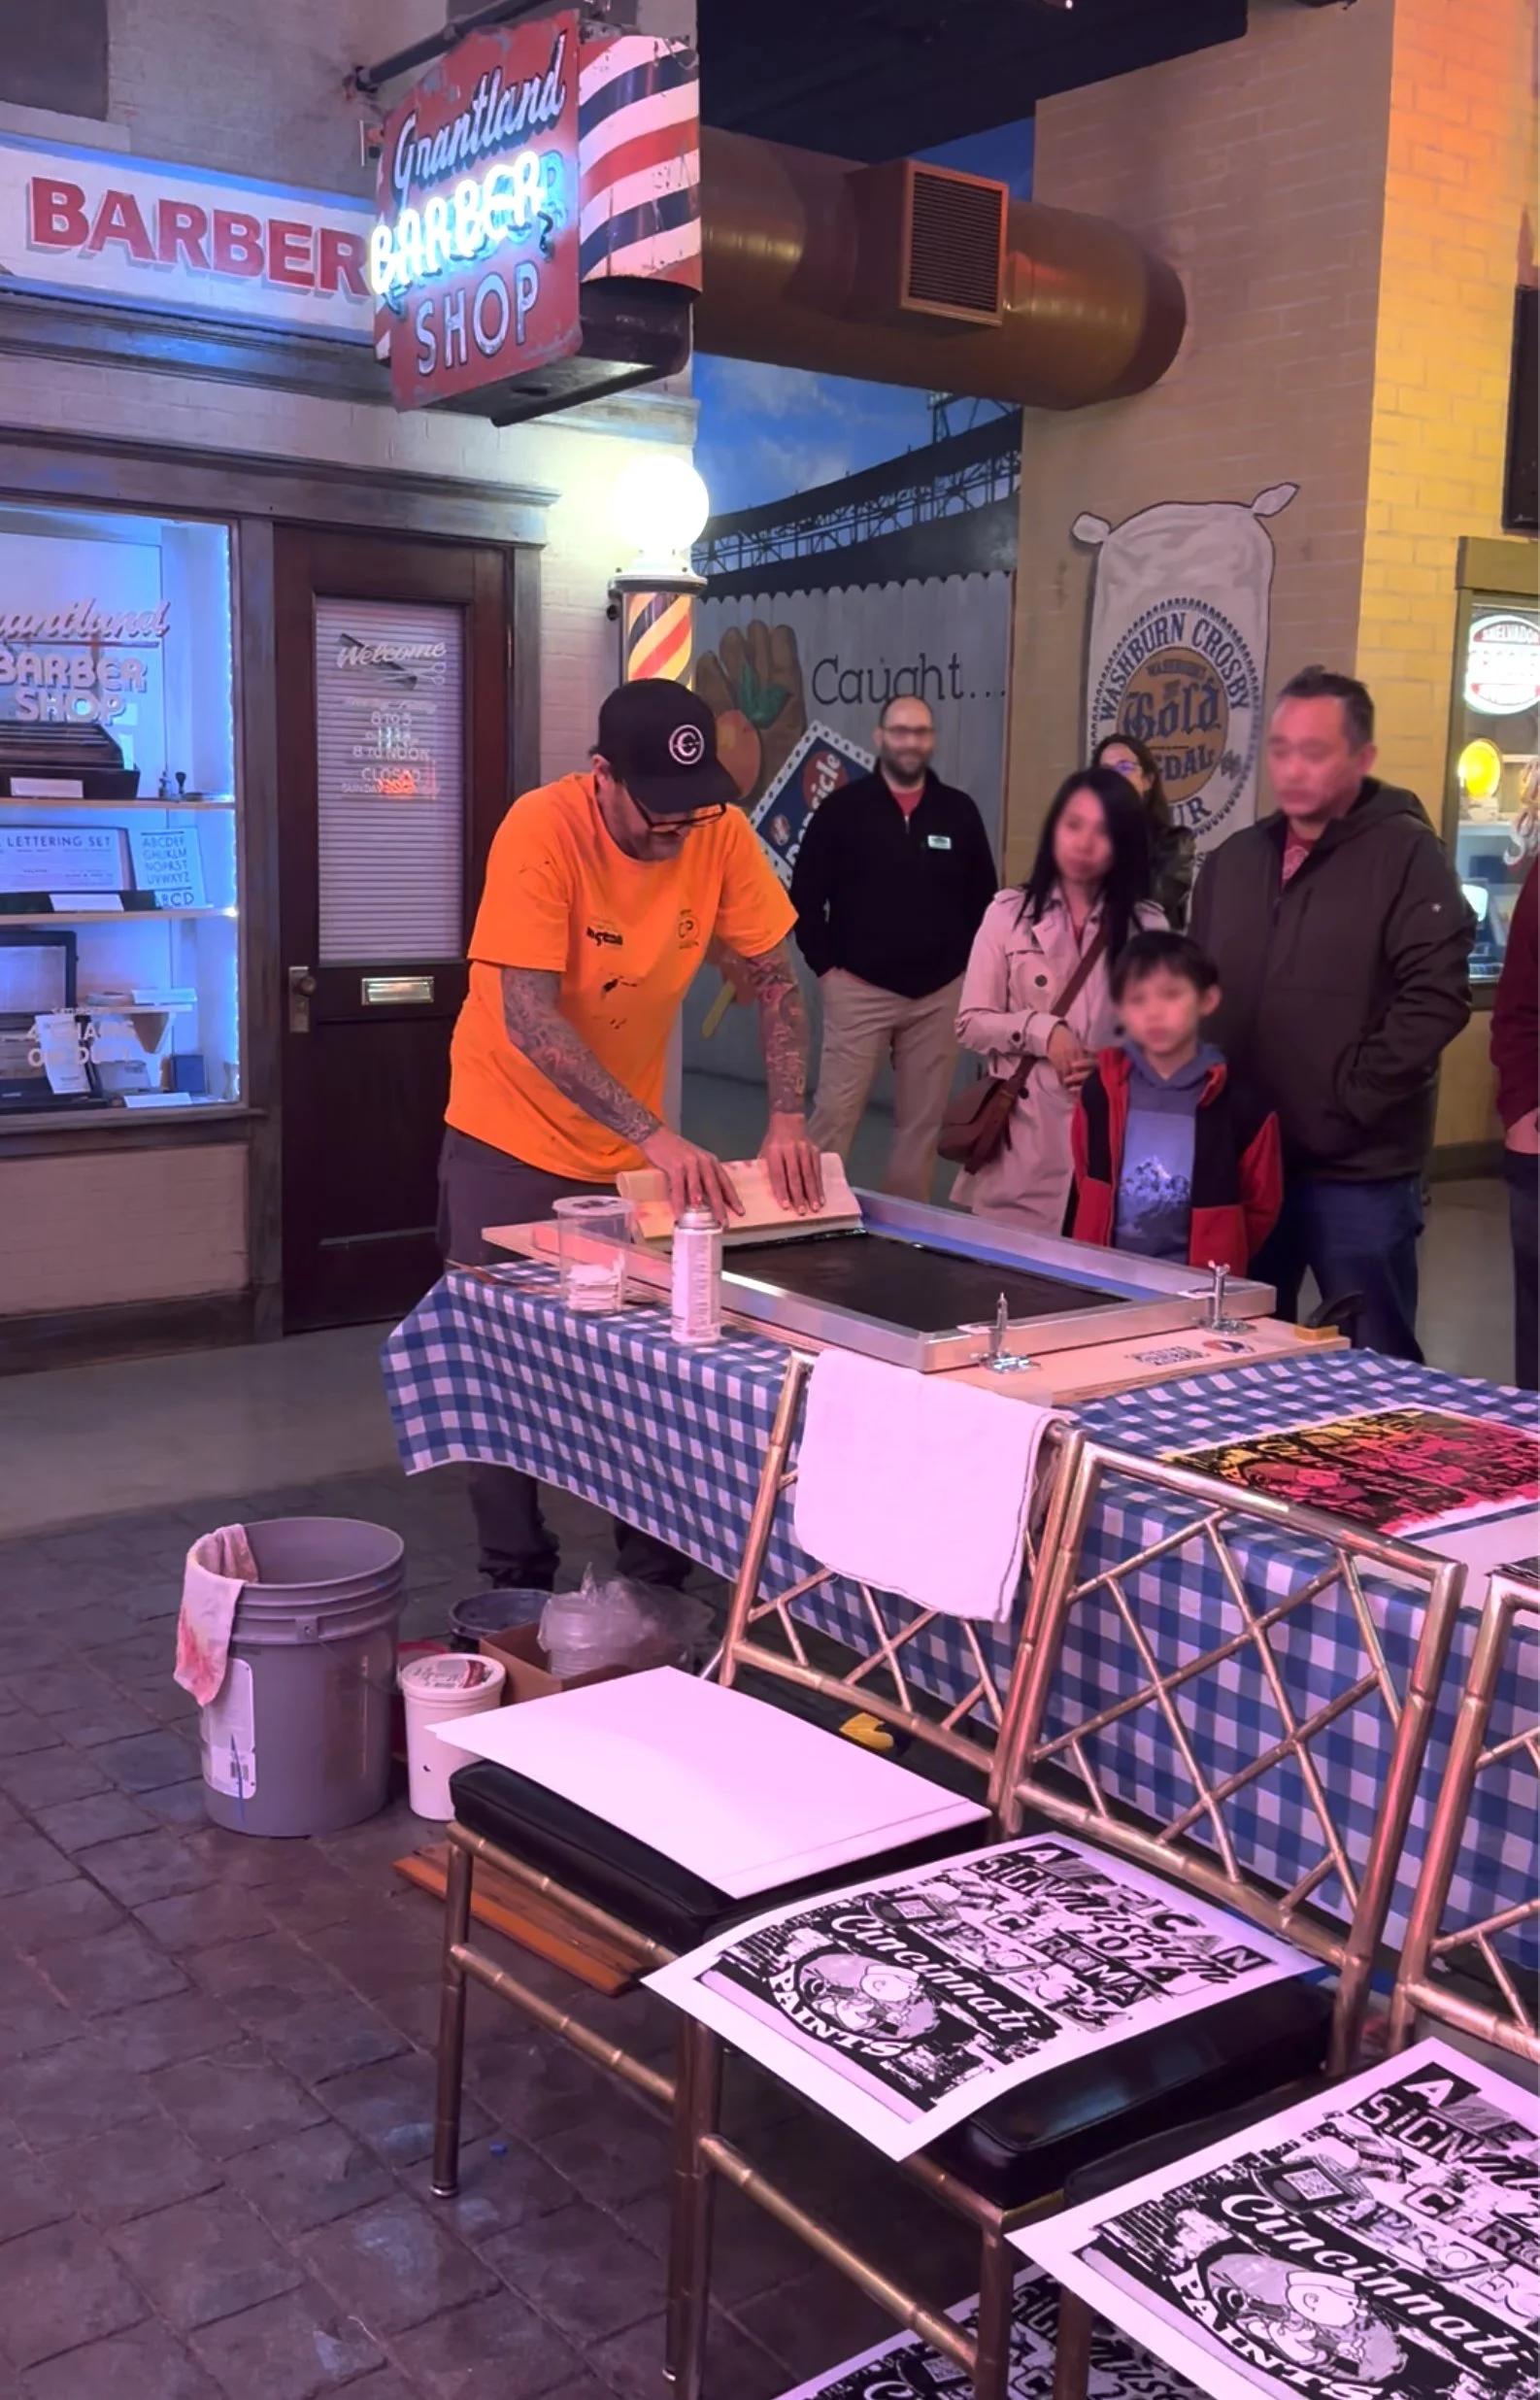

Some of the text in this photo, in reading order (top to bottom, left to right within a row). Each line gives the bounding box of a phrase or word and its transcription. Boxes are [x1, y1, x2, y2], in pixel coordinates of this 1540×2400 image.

[393, 30, 569, 215] Grantland
[28, 176, 372, 298] BARBER
[370, 151, 570, 294] BARBER
[416, 259, 540, 377] SHOP
[0, 652, 148, 693] BARBER
[336, 641, 447, 668] Welcome
[1100, 612, 1251, 722] WASHBURN CROSBY
[15, 689, 127, 726] SHOP
[1123, 676, 1222, 742] Gold
[7, 835, 112, 849] LETTERING SET
[968, 1854, 1066, 1895] SIGN
[768, 1963, 914, 2058] PAINTS
[830, 1914, 1043, 2033] Cincinnati
[1353, 2091, 1482, 2165] SIGN
[1169, 2260, 1384, 2400] PAINTS
[1221, 2194, 1535, 2369] Cincinnati
